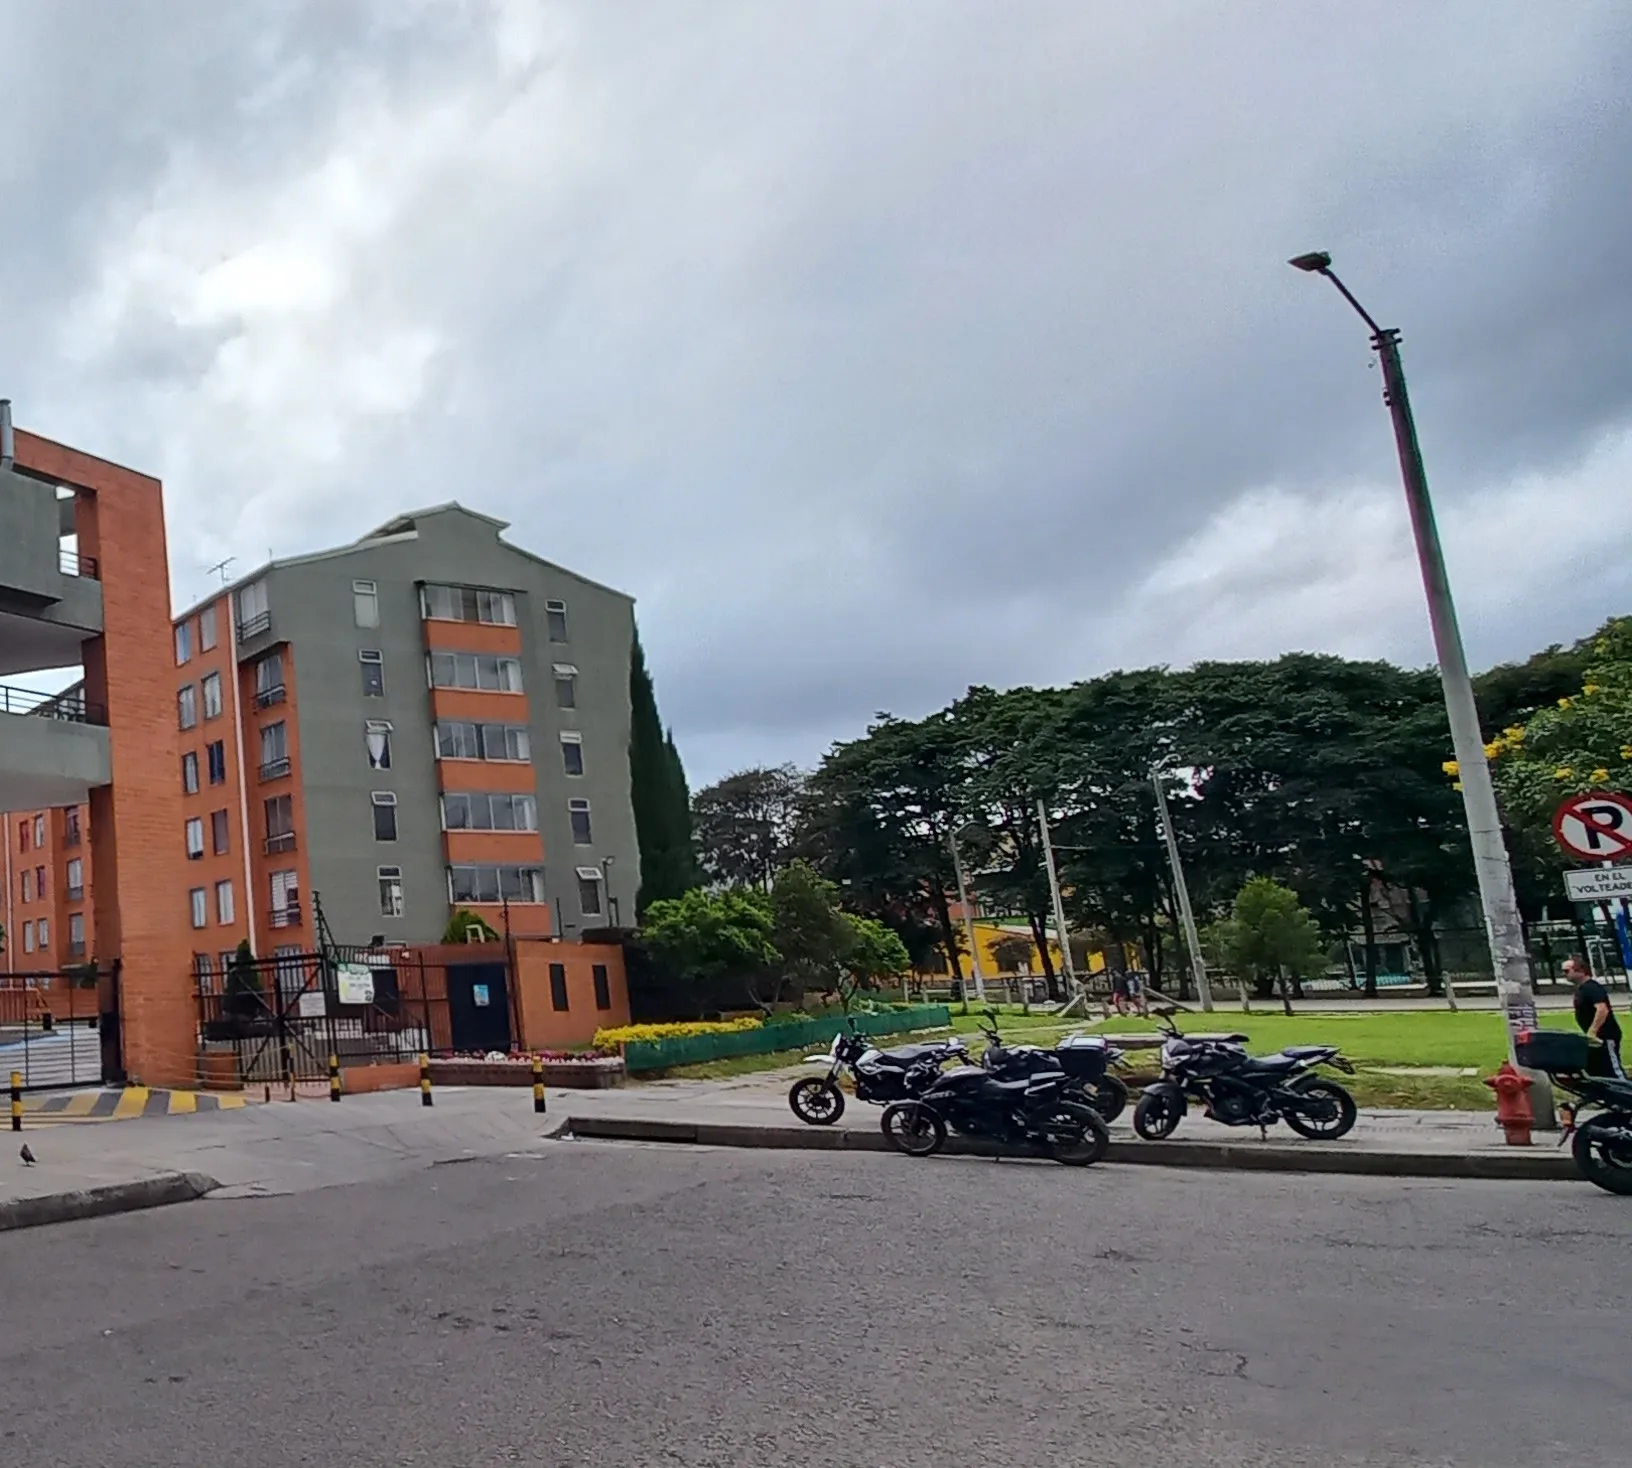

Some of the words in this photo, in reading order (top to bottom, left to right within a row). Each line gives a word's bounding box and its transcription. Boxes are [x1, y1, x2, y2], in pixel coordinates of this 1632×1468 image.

[1580, 805, 1623, 849] P
[1594, 873, 1610, 882] EN
[1612, 872, 1626, 881] EL
